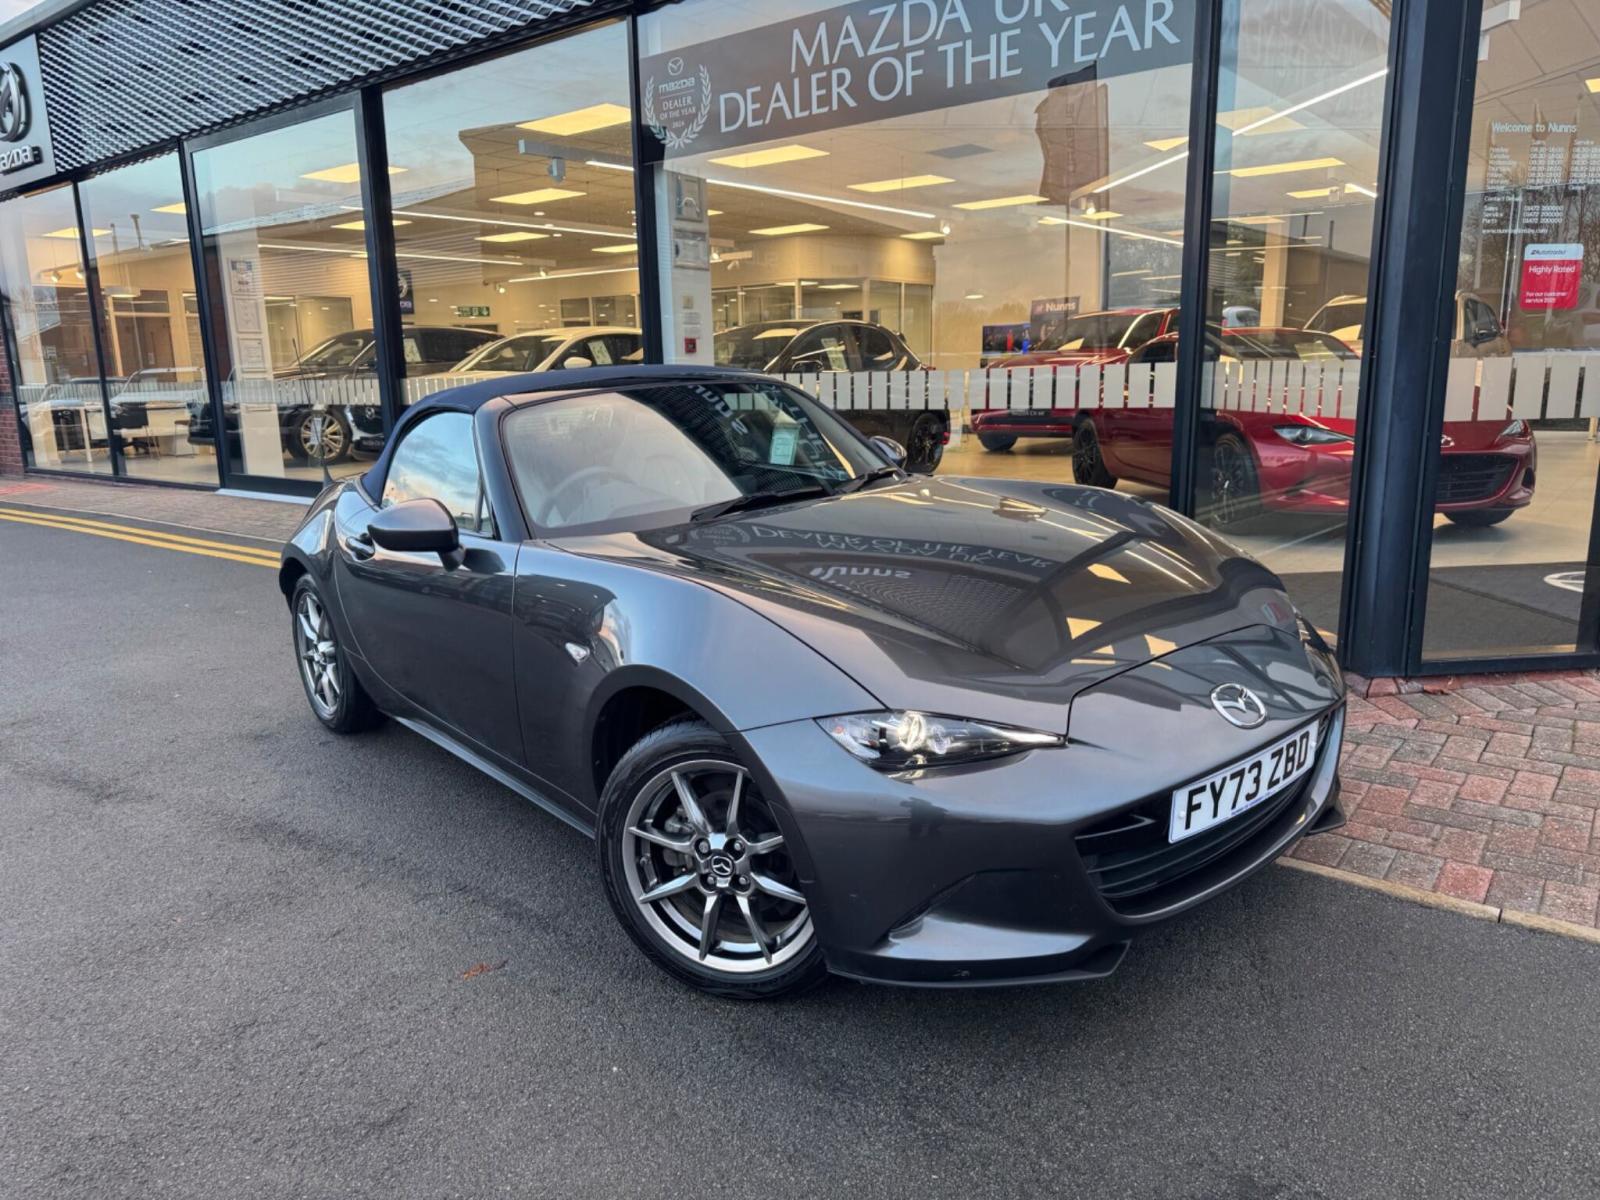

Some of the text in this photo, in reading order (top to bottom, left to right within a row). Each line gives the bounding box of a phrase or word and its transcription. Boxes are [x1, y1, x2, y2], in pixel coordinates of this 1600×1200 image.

[791, 0, 972, 73] MAZDA
[720, 0, 1181, 133] DEALER OF THE YEAR
[662, 96, 692, 111] DEALER
[681, 106, 696, 116] YEAR
[1491, 122, 1577, 133] Welcome to Nunns
[0, 145, 31, 170] azda
[1528, 264, 1576, 275] Highly Rated
[1185, 760, 1263, 830] FY73
[1267, 731, 1310, 790] ZBD
